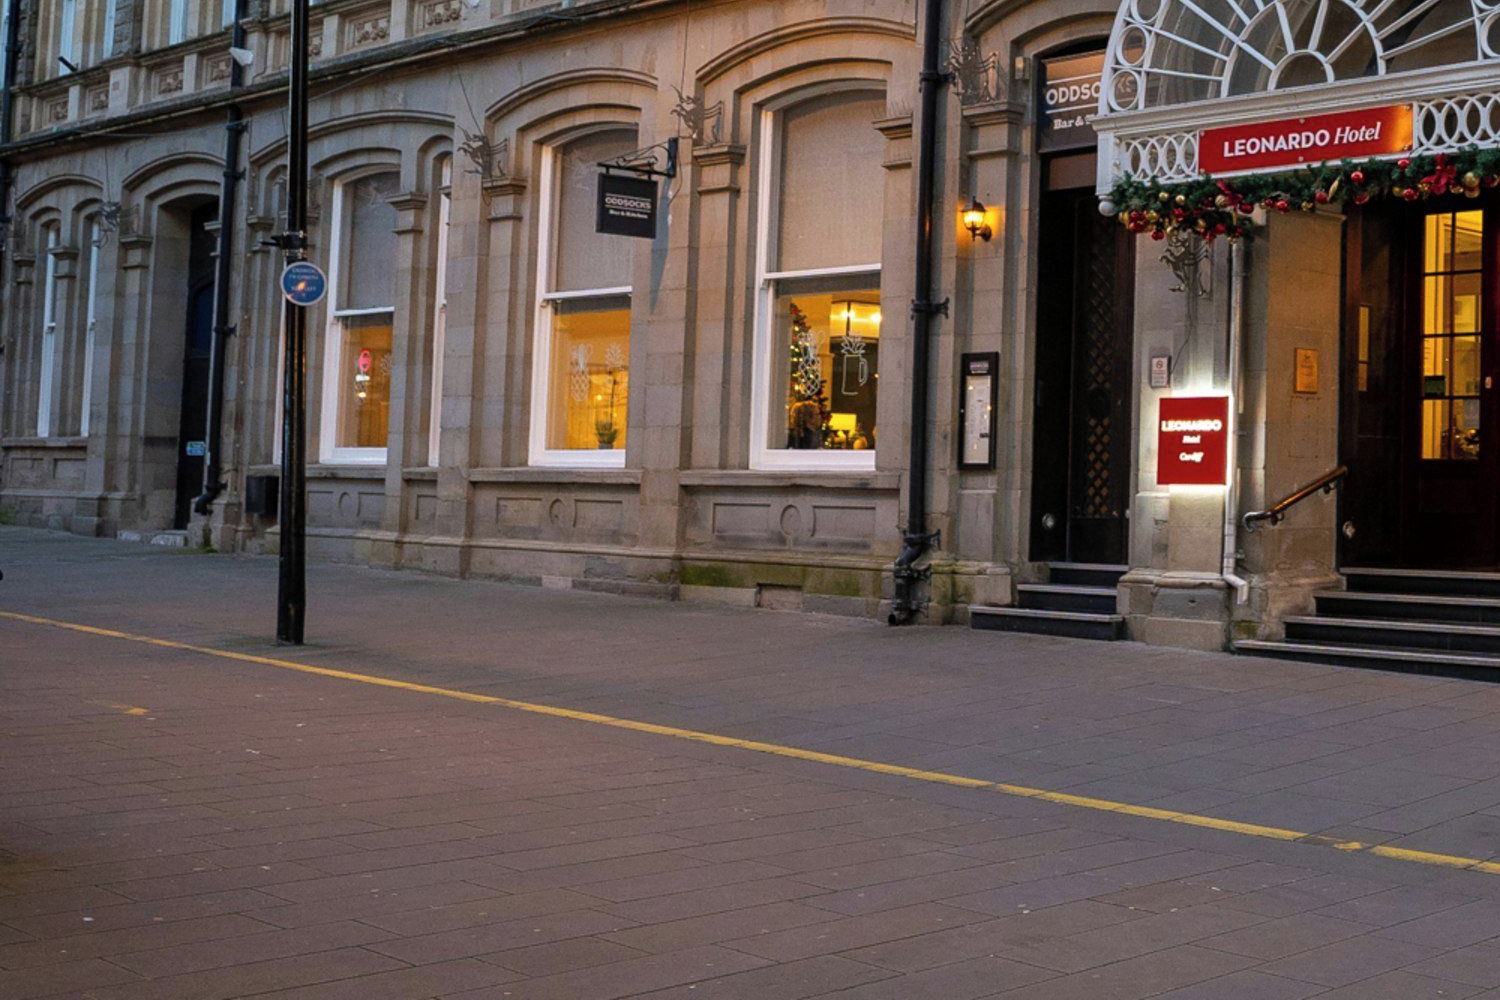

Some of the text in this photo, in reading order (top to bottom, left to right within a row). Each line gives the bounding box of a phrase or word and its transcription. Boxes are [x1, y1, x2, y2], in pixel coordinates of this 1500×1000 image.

[1053, 118, 1074, 131] Bar
[1075, 115, 1084, 127] &
[1223, 121, 1382, 158] LEONARDO Hotel
